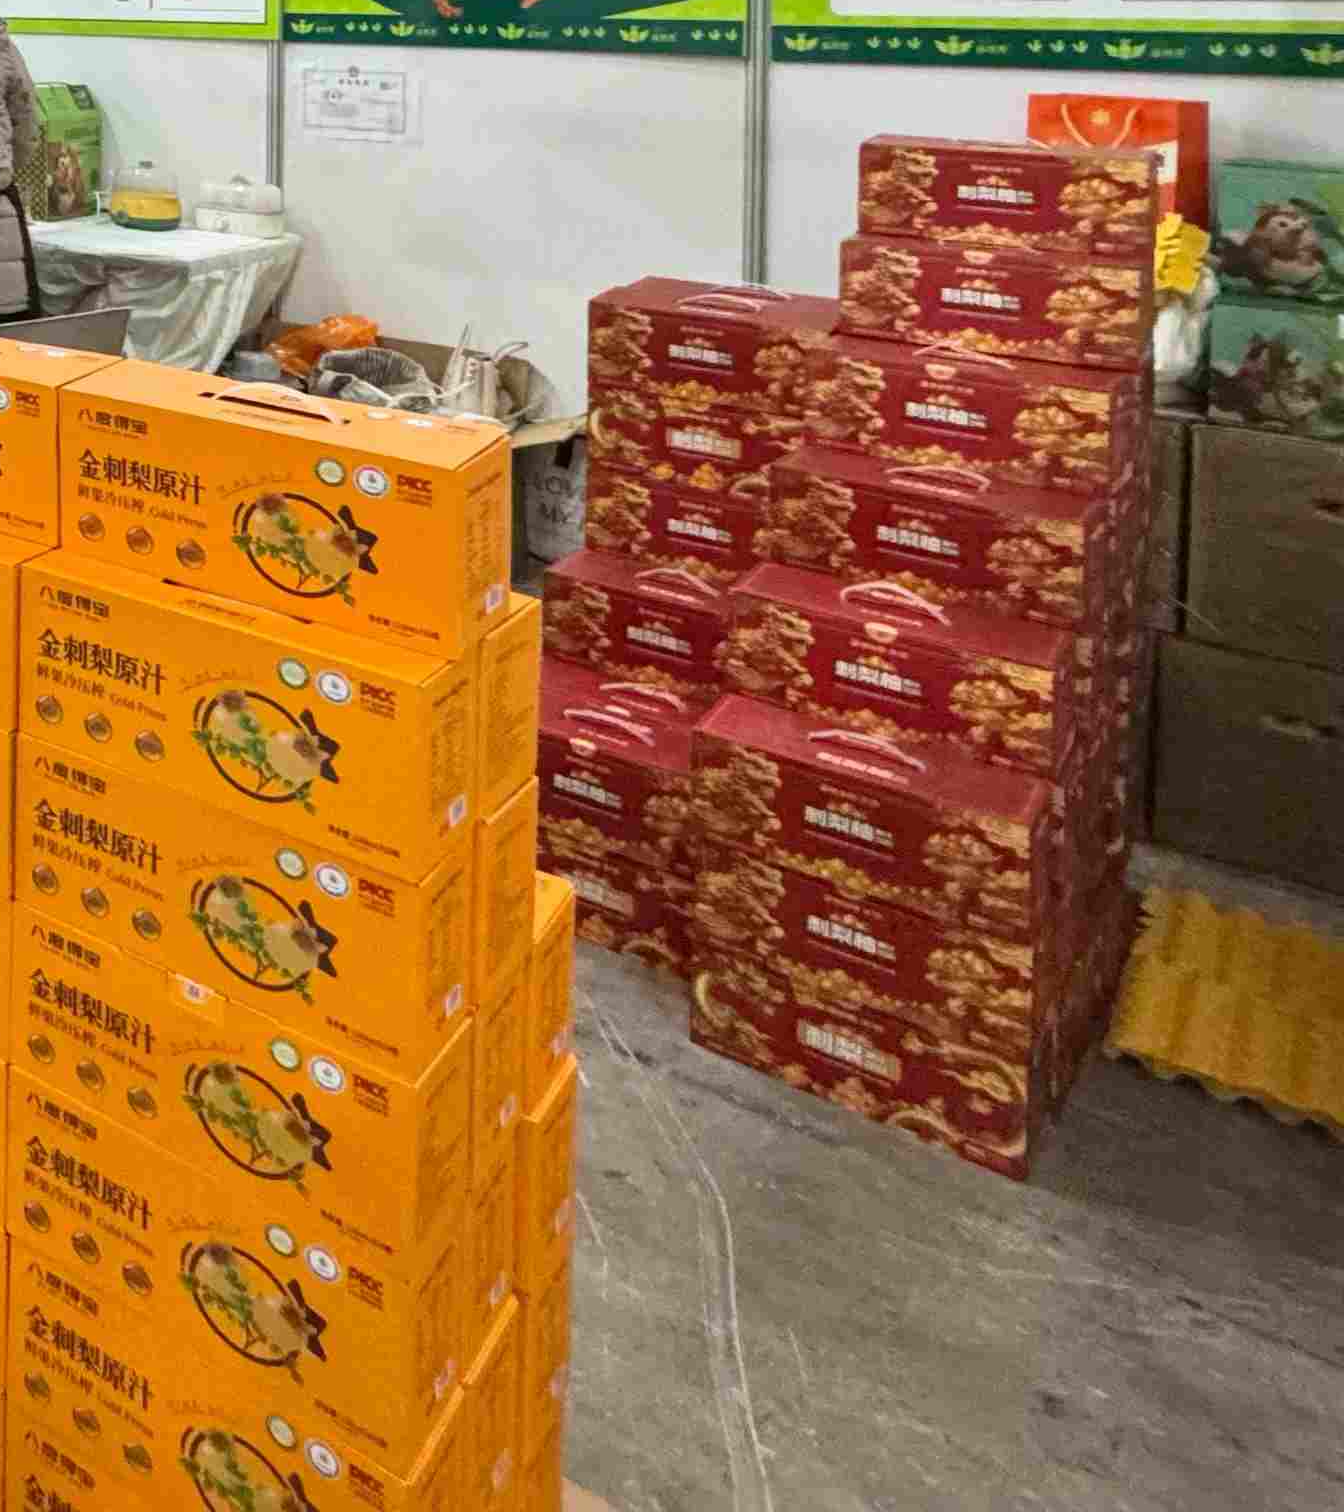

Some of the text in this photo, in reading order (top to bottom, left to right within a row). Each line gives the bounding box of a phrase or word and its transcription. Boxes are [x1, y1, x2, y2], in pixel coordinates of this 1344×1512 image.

[78, 447, 207, 505] 金刺梨原汁
[37, 628, 167, 696] 金刺梨原汁
[32, 798, 163, 876] 金刺梨原汁
[28, 967, 157, 1055] 金刺梨原汁
[24, 1134, 153, 1231] 金刺梨原汁
[24, 1304, 153, 1412] 金刺梨原汁
